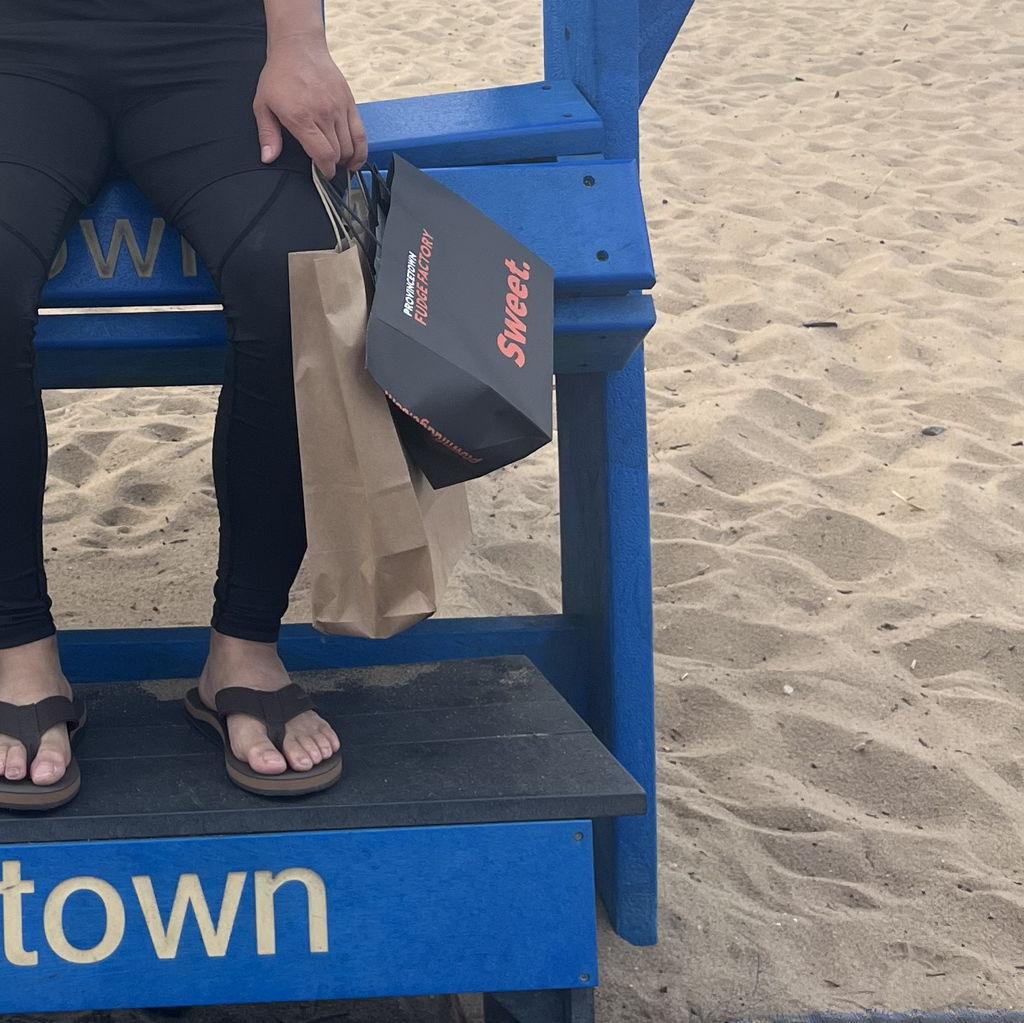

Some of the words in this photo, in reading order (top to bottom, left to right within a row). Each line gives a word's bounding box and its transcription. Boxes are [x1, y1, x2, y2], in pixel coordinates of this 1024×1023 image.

[403, 250, 417, 317] PROVINCETOWN
[417, 228, 434, 286] FACTORY
[414, 281, 428, 326] FUDGE
[496, 258, 531, 368] Sweet.
